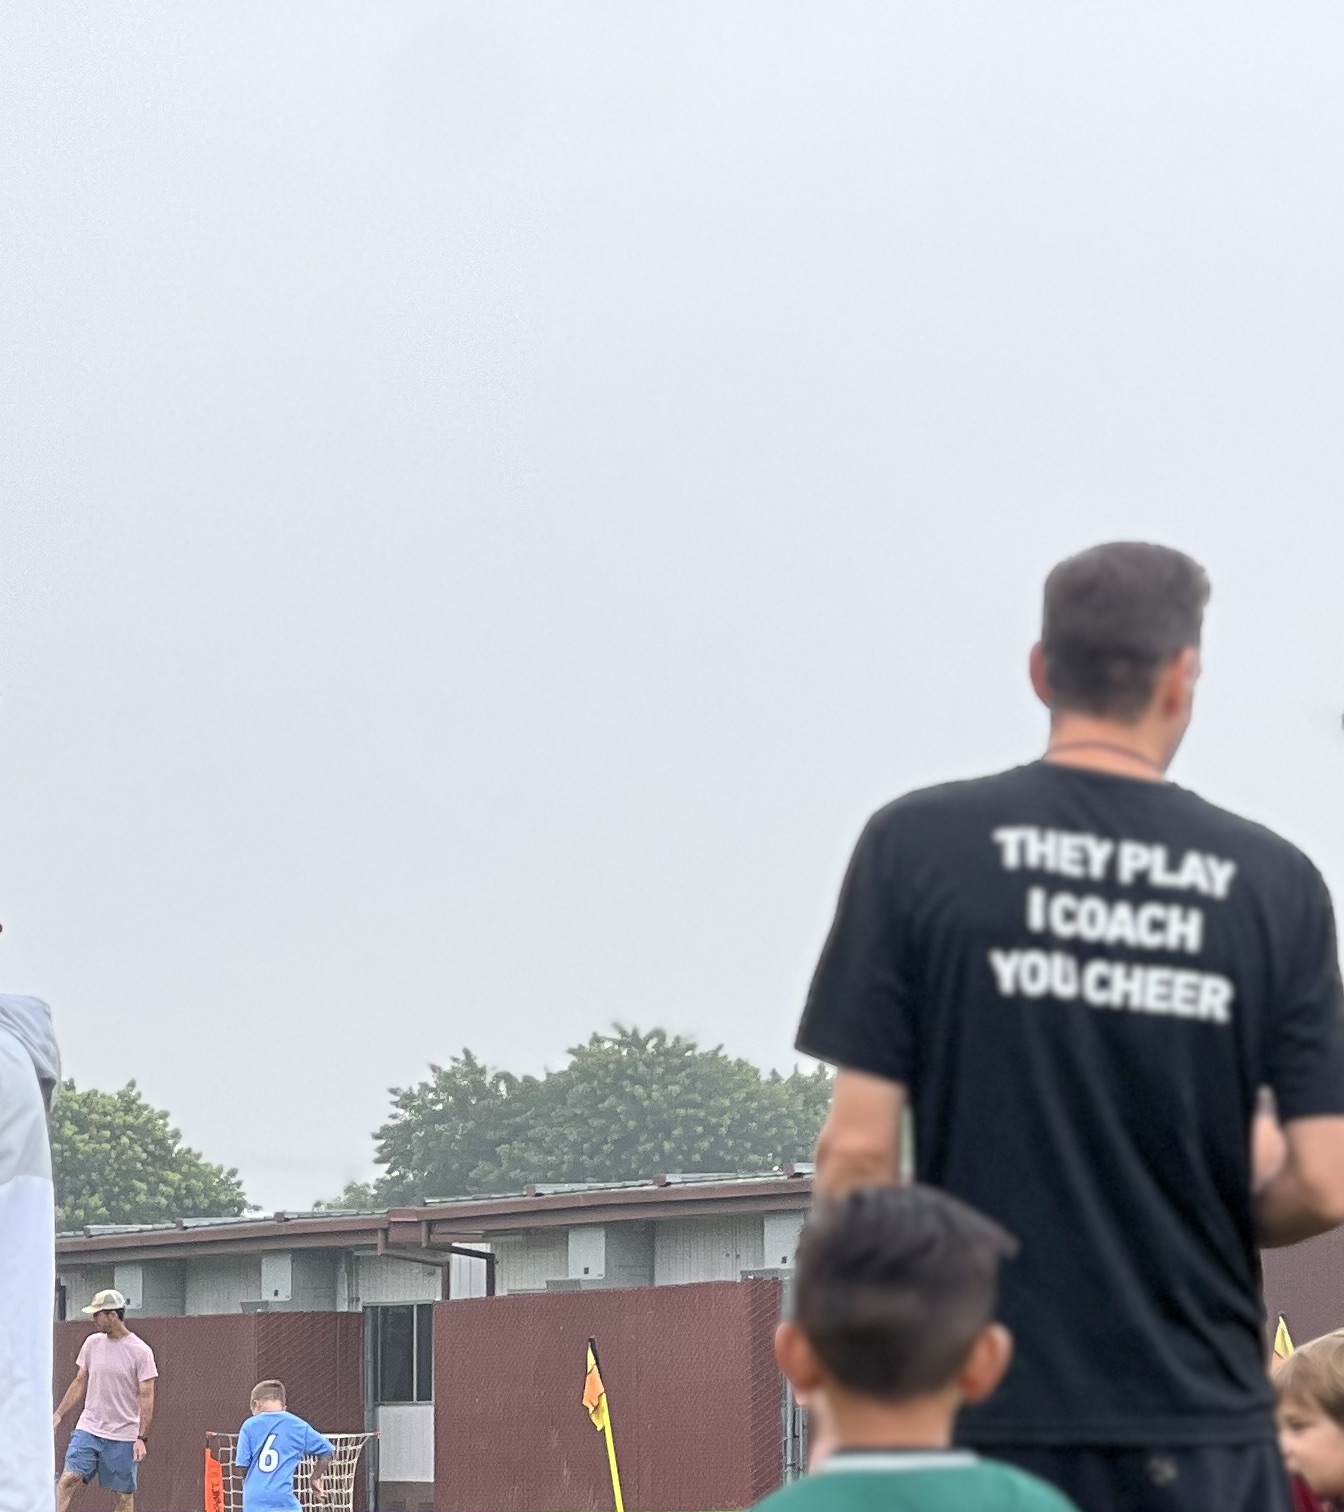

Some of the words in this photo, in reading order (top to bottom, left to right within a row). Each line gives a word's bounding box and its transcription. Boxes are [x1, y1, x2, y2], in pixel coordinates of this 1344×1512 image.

[992, 826, 1114, 880] THEY
[1117, 838, 1236, 900] PLAY
[1027, 887, 1046, 932] I
[1049, 891, 1203, 952] COACH
[989, 949, 1079, 998] YOU
[1082, 959, 1235, 1024] CHEER
[258, 1433, 279, 1472] 6
